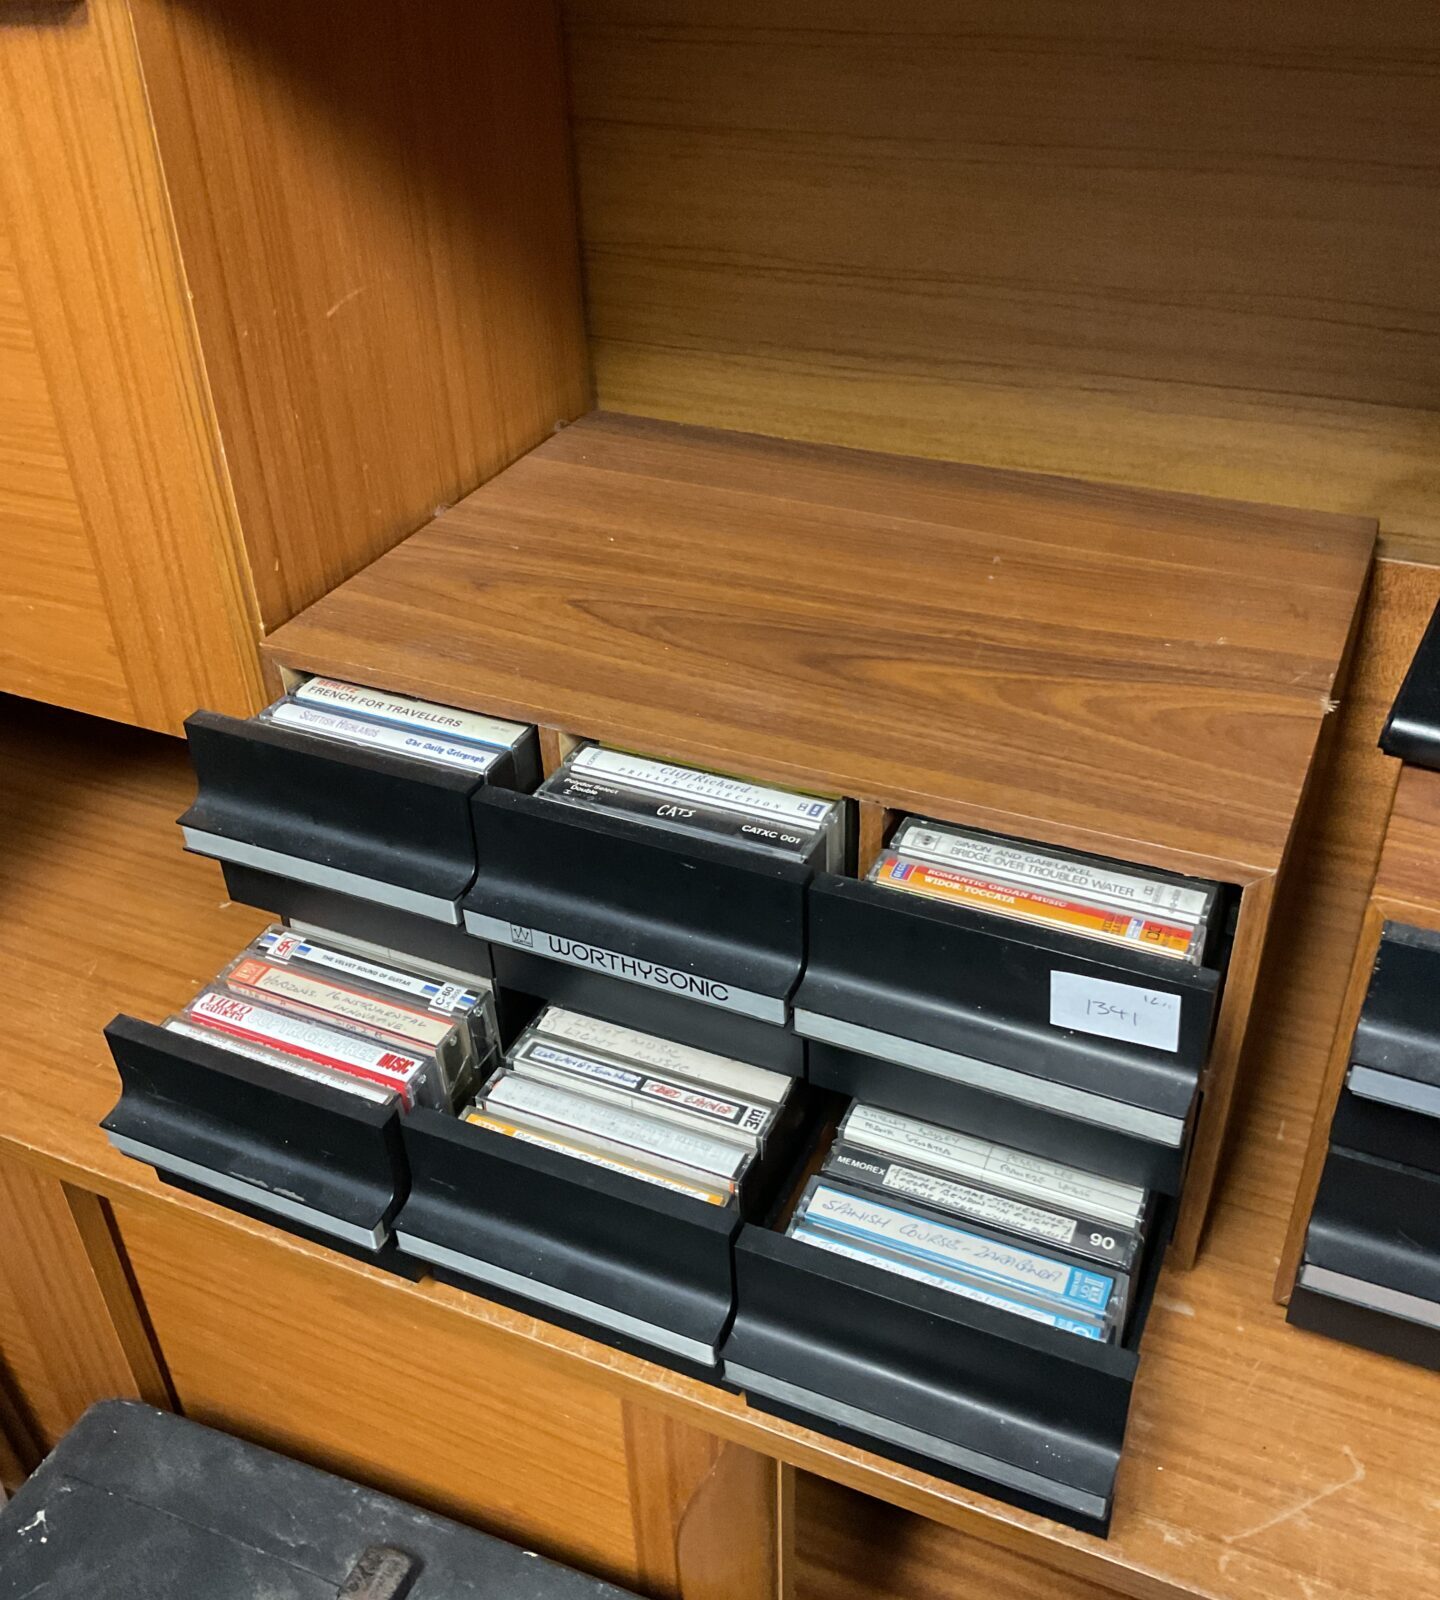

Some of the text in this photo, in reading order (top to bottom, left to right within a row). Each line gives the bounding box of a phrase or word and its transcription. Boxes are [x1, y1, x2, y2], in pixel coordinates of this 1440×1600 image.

[308, 685, 463, 728] FRENCH FOR TRAVELLERS
[405, 738, 486, 764] The Daily Telegraph
[564, 777, 619, 796] Polydor Select
[570, 784, 599, 796] Double
[618, 767, 781, 810] PRIVATE COLLECTION
[659, 765, 752, 794] Cliff Richard
[655, 803, 697, 819] CATS
[741, 824, 801, 845] CATXC 001
[954, 840, 1092, 876] SIMON AND GARFUNKEL
[950, 847, 991, 862] BRIDGE
[994, 856, 1026, 871] OVER
[1027, 864, 1088, 886] TROUBLED
[1091, 877, 1135, 898] WATER
[927, 867, 1068, 908] ROMANTIC ORGAN MUSIC
[963, 884, 1017, 903] TOCCATA
[321, 954, 412, 987] THE VELVET SOUND OF GUITAR
[548, 934, 730, 1003] WORTHYSONIC
[209, 994, 254, 1015] VIDEO
[435, 986, 454, 1006] C-60
[200, 1001, 245, 1022] camera
[1086, 998, 1137, 1027] 1341
[375, 1052, 415, 1075] MUSIC
[837, 1155, 886, 1176] MEMOREX
[822, 1200, 890, 1228] SPANISH
[1088, 1232, 1116, 1250] 90
